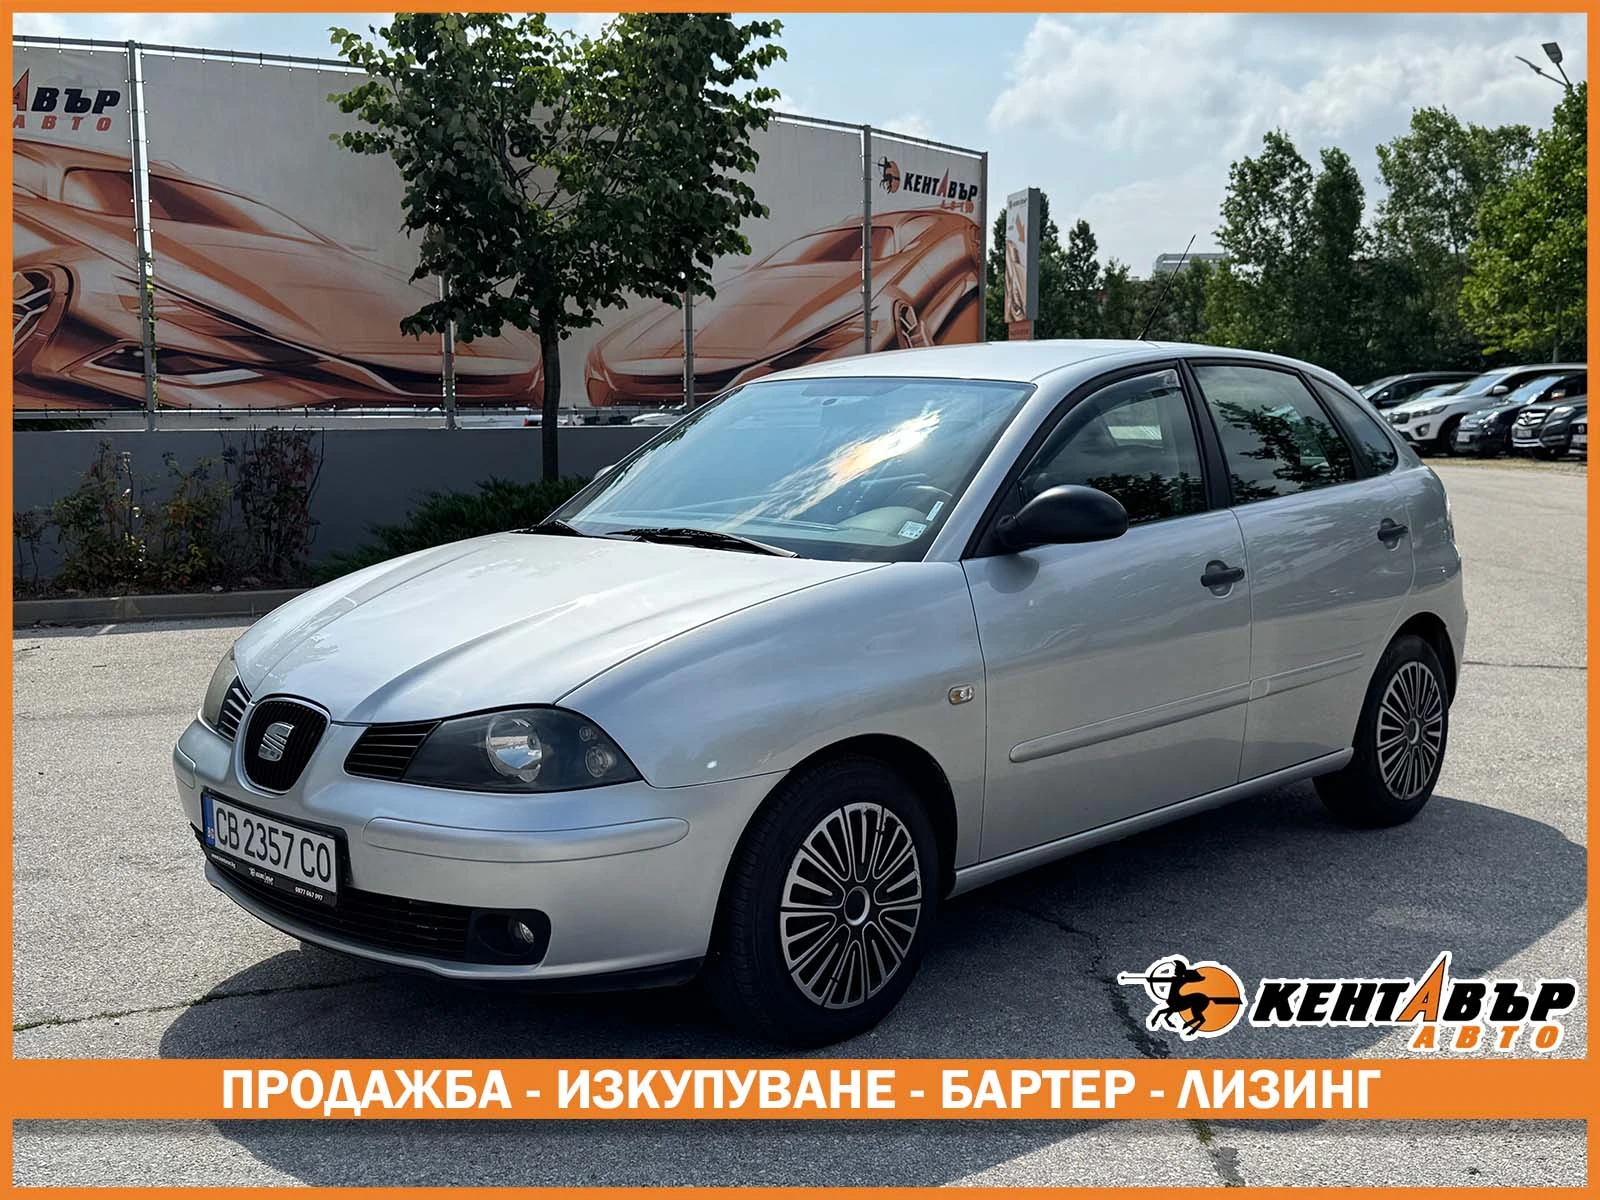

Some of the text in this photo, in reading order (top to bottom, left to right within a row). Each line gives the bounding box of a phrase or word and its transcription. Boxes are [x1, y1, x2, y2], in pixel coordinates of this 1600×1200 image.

[904, 168, 978, 201] КЕНТАВЪР
[216, 808, 331, 883] CB 2357 CO
